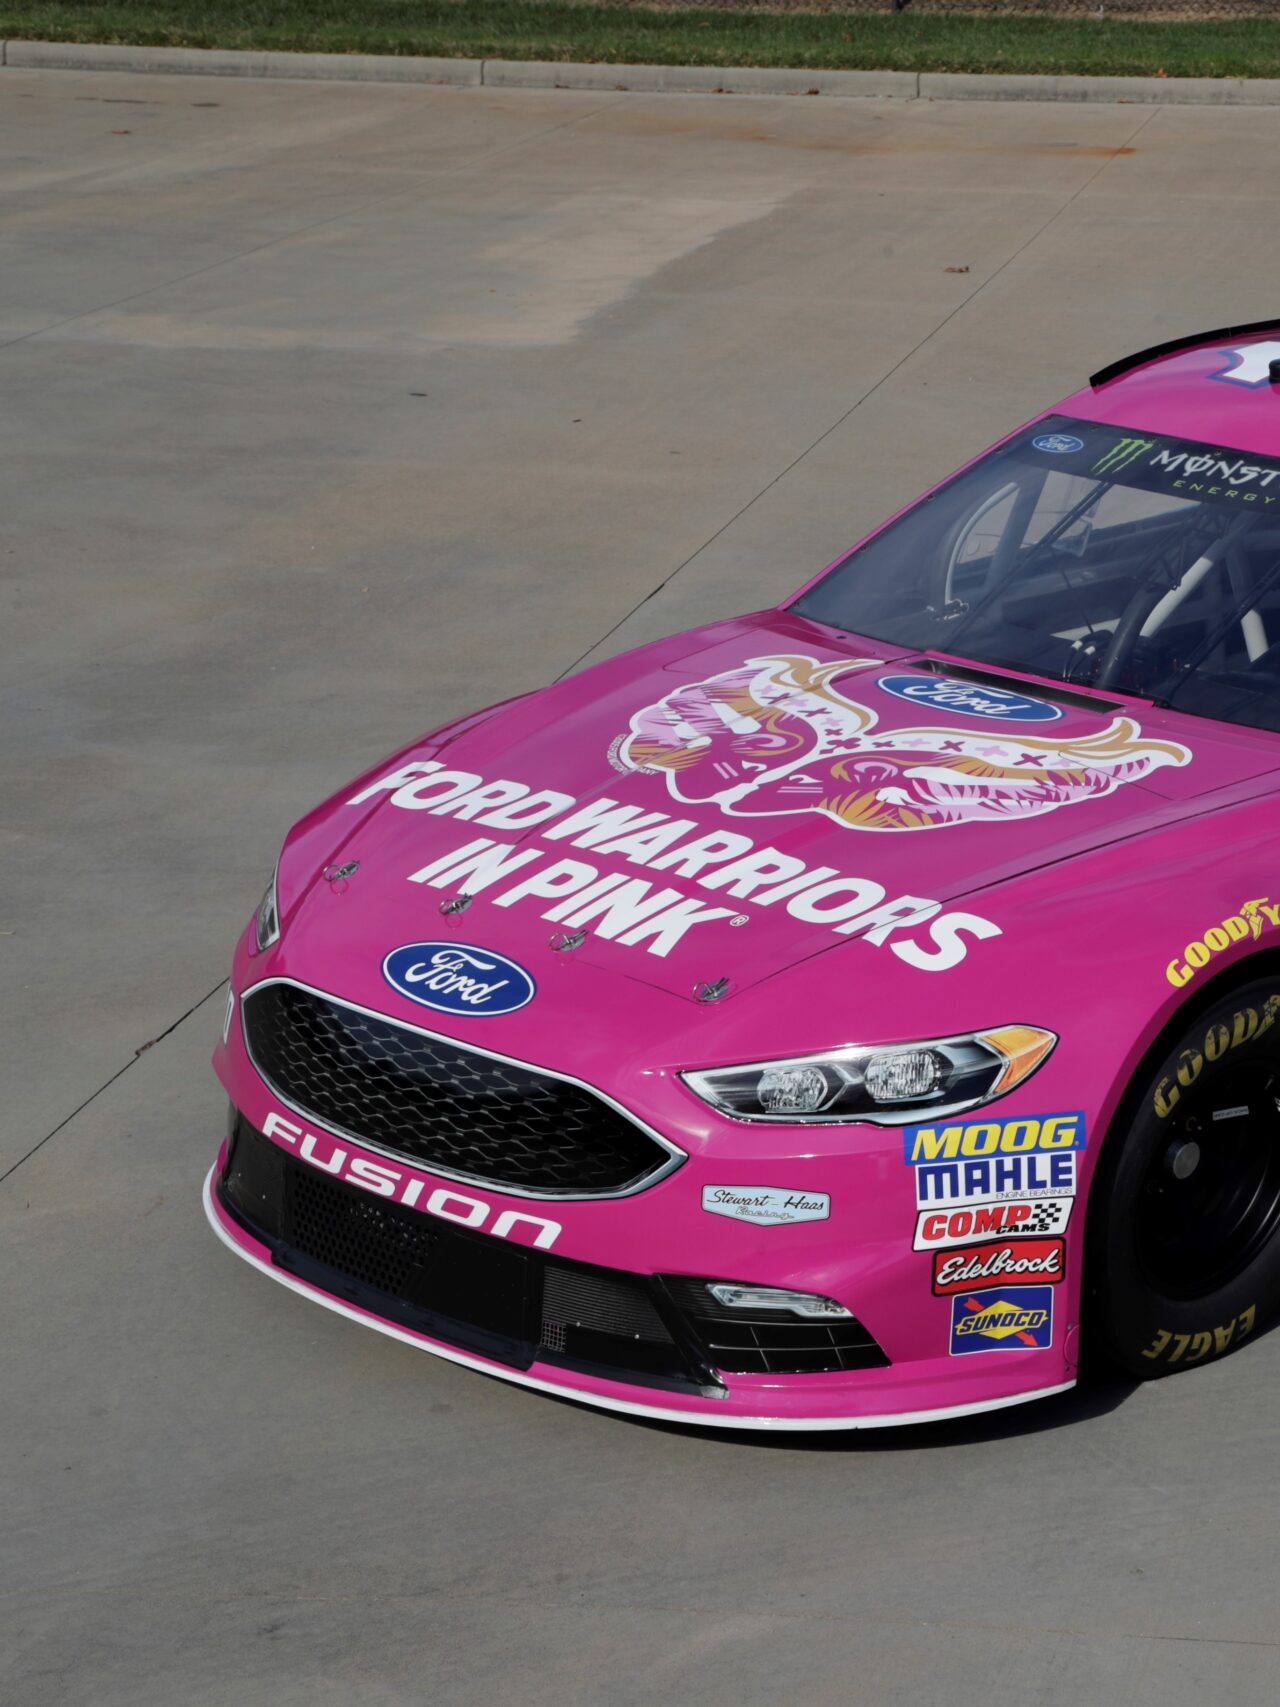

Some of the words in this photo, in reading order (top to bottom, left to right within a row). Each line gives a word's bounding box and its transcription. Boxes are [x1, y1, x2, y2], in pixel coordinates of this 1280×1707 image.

[1038, 436, 1076, 451] Ford
[1173, 479, 1276, 504] ENERGY
[902, 679, 1032, 715] Ford
[344, 760, 577, 831] FORD
[540, 797, 1004, 973] WARRIORS
[406, 837, 545, 897] IN
[404, 949, 510, 1005] Ford
[911, 1115, 1079, 1161] MOOG
[261, 1111, 563, 1250] FUSION
[917, 1153, 1073, 1201] MAHLE
[995, 1189, 1027, 1200] ENGINE
[1029, 1186, 1073, 1197] BEARINGS
[706, 1189, 776, 1207] Stewart
[783, 1195, 824, 1211] Haas
[735, 1205, 796, 1220] Racing
[921, 1204, 1033, 1241] COMP
[995, 1222, 1051, 1235] CAMS
[935, 1247, 1061, 1286] Edelbrock
[958, 1309, 1047, 1334] SUNOCO
[1140, 1303, 1257, 1363] EAGLE
